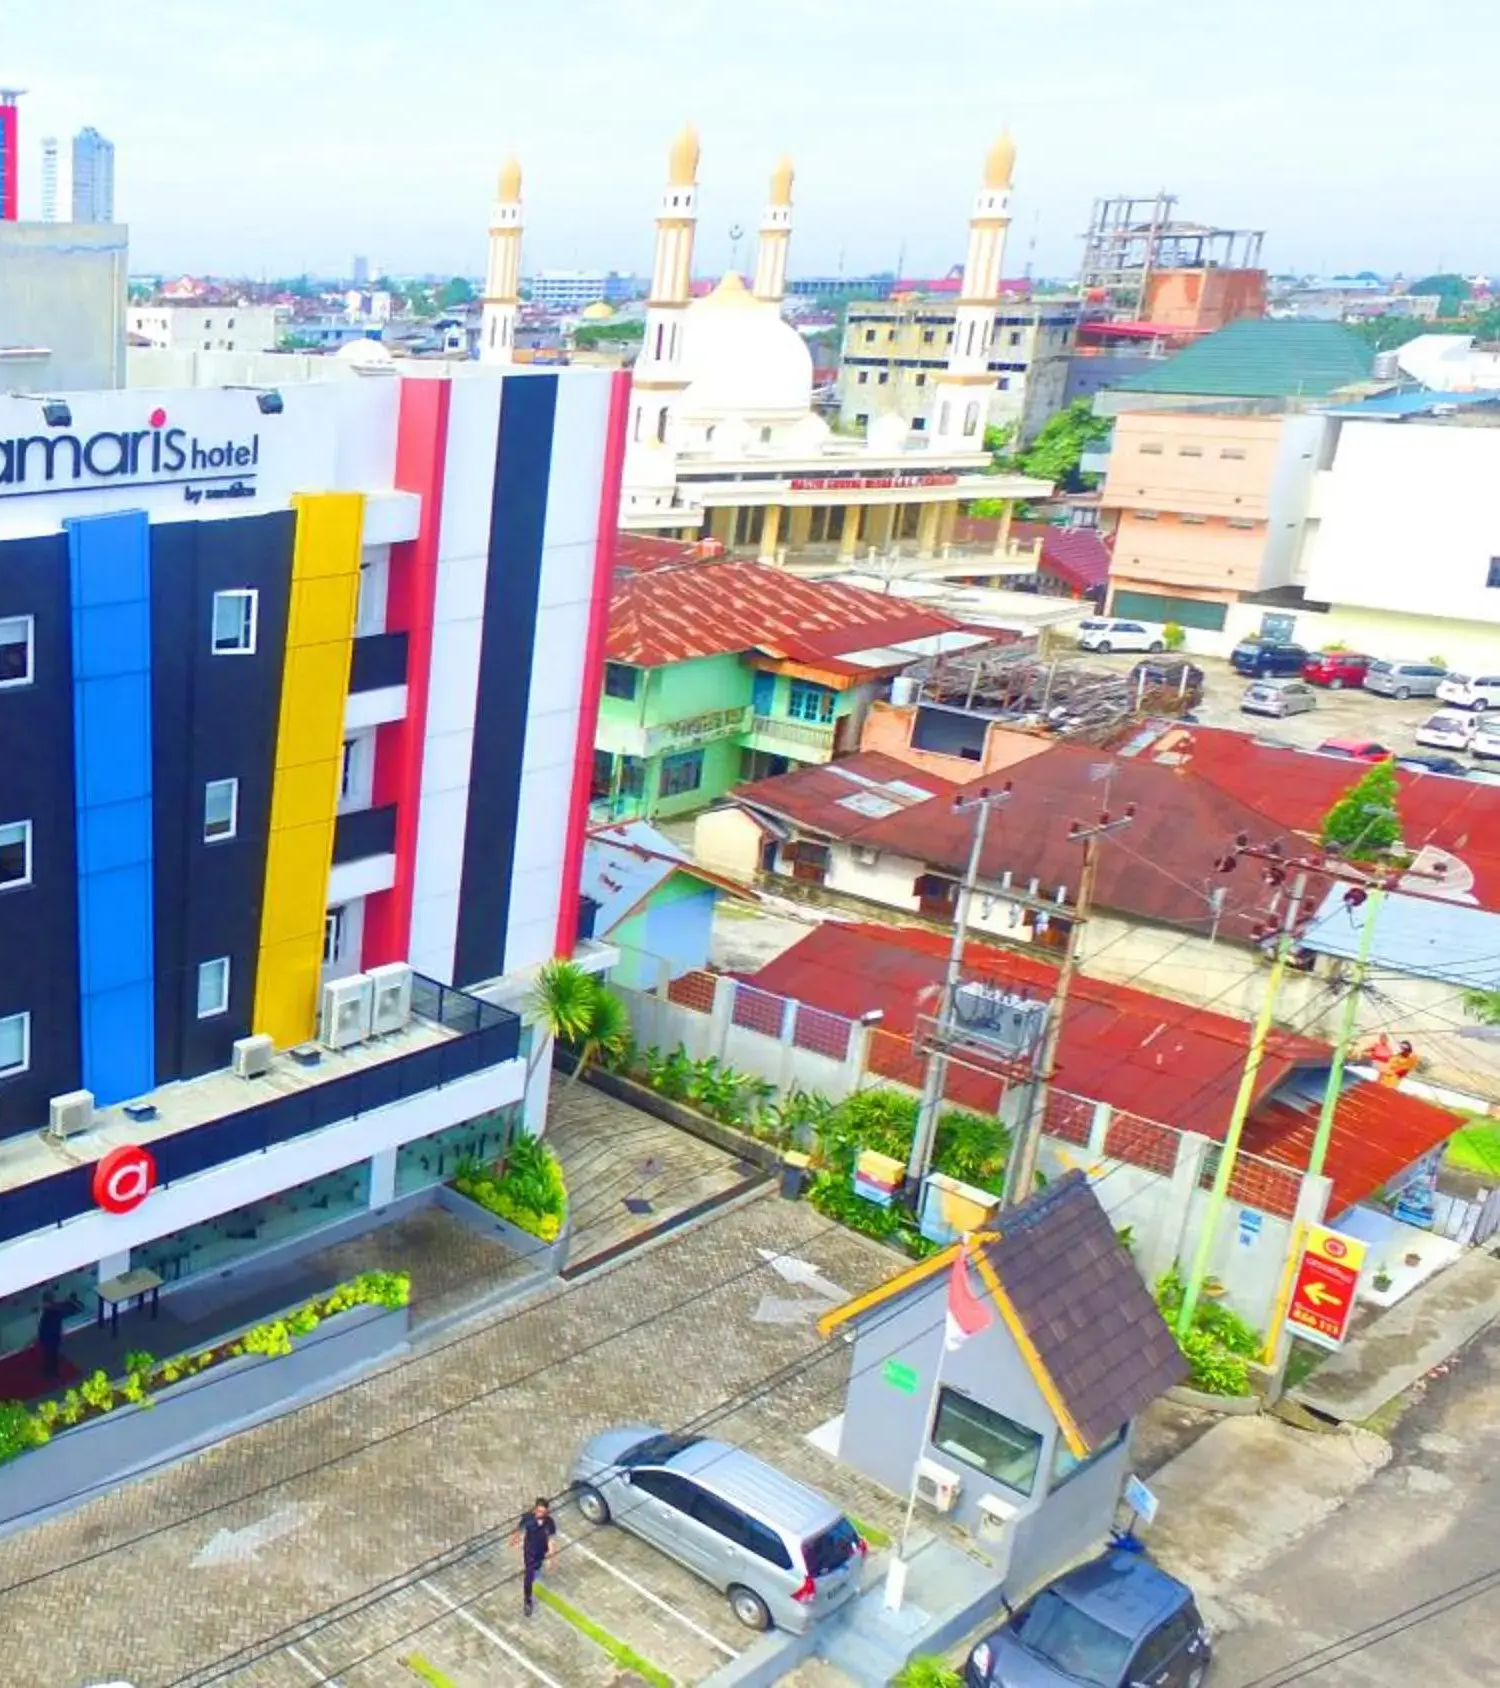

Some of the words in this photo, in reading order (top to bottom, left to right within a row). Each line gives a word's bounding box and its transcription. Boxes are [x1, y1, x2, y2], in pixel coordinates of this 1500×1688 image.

[191, 433, 259, 469] hotel
[184, 485, 202, 505] by
[108, 1161, 148, 1201] a
